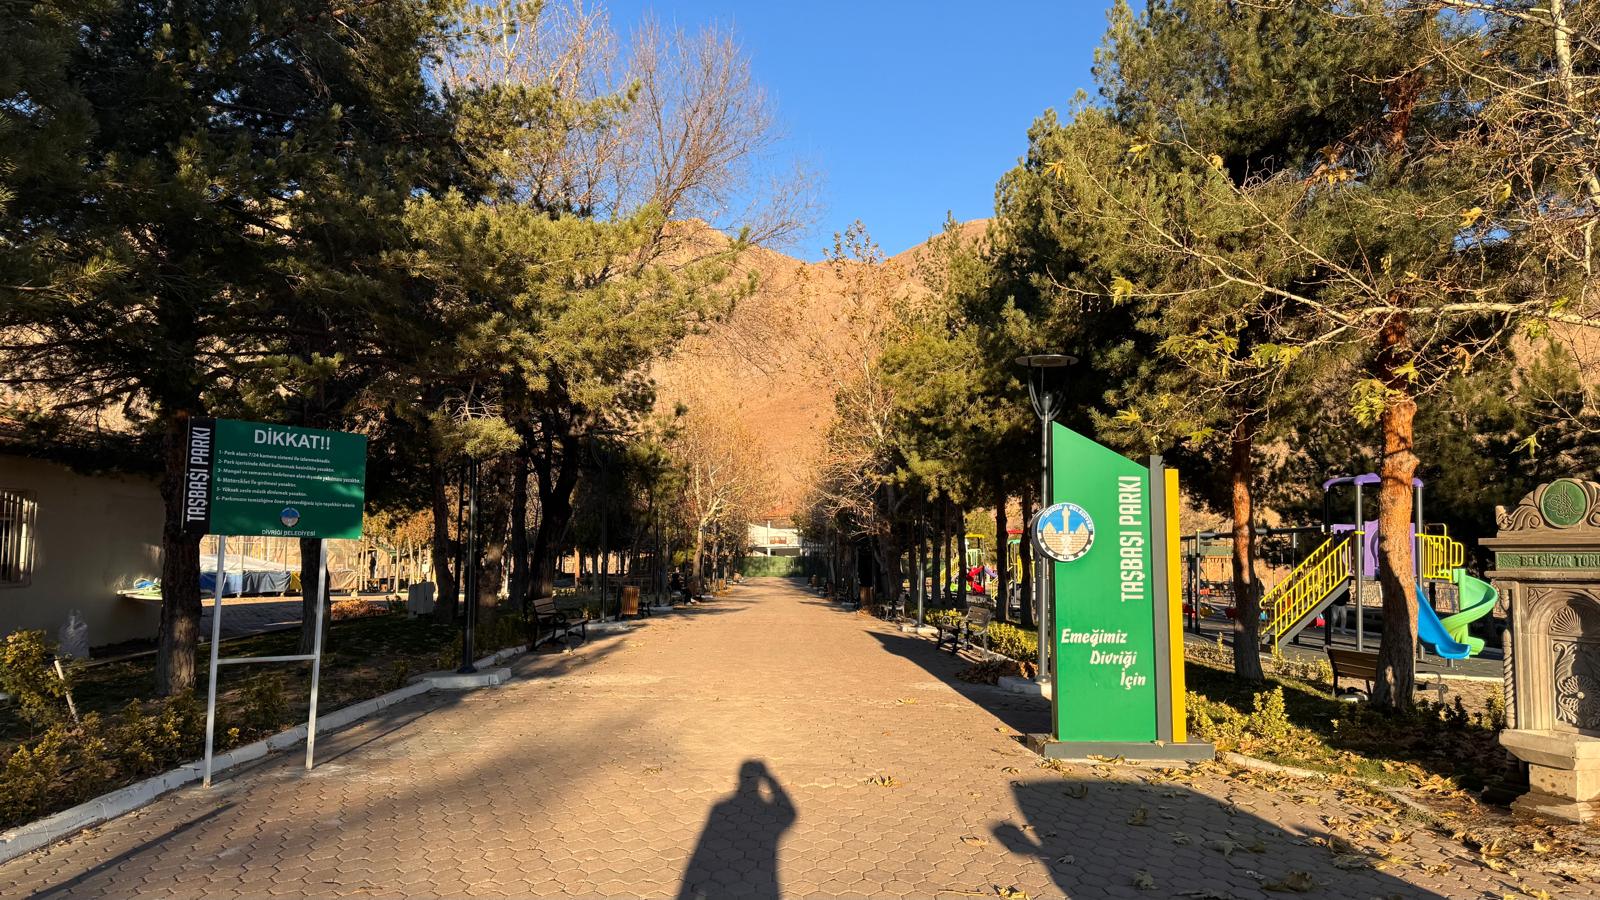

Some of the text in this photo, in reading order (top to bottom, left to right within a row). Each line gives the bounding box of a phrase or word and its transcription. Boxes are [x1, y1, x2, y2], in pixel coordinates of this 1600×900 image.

[254, 427, 330, 450] DİKKAT!!
[186, 426, 211, 522] TAŞBAŞI PARKI
[1118, 476, 1145, 602] TAŞBAŞI PARKI
[1521, 554, 1572, 568] BELGÜZAR
[1061, 628, 1128, 648] Emeğimiz
[1089, 650, 1138, 668] Divriği
[1120, 668, 1146, 690] İçin
